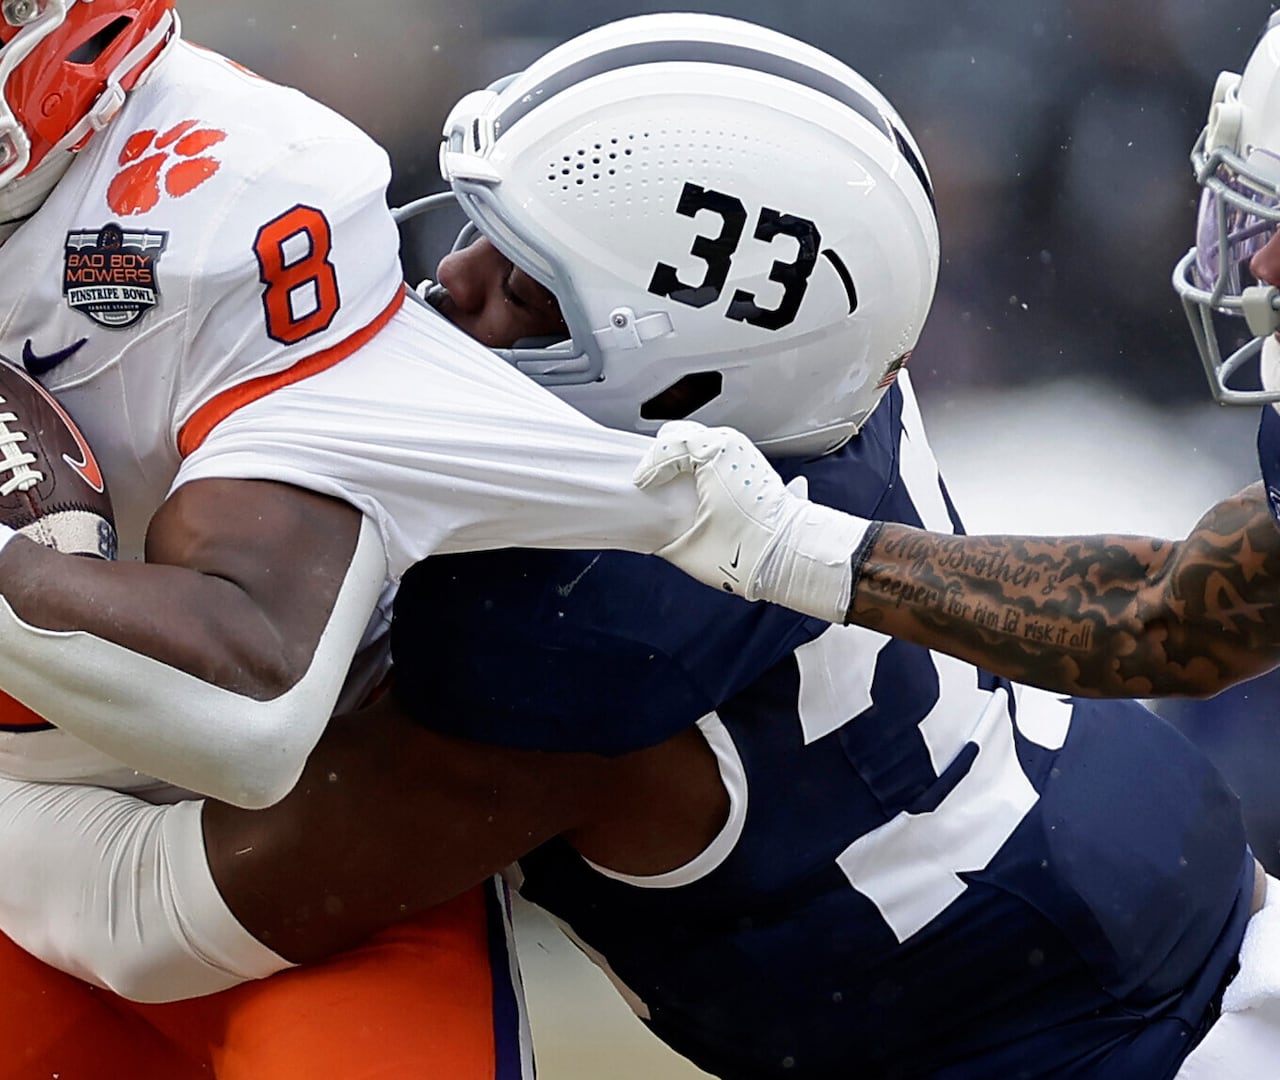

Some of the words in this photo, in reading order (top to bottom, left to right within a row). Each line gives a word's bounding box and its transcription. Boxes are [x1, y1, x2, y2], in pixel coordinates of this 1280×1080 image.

[67, 254, 105, 268] BAD
[110, 254, 151, 268] BOY
[647, 181, 822, 331] 33
[66, 268, 152, 283] MOWERS
[253, 204, 341, 346] 8
[70, 287, 120, 304] PINSTRIPE
[123, 287, 153, 302] BOWL
[1023, 619, 1054, 642] risk
